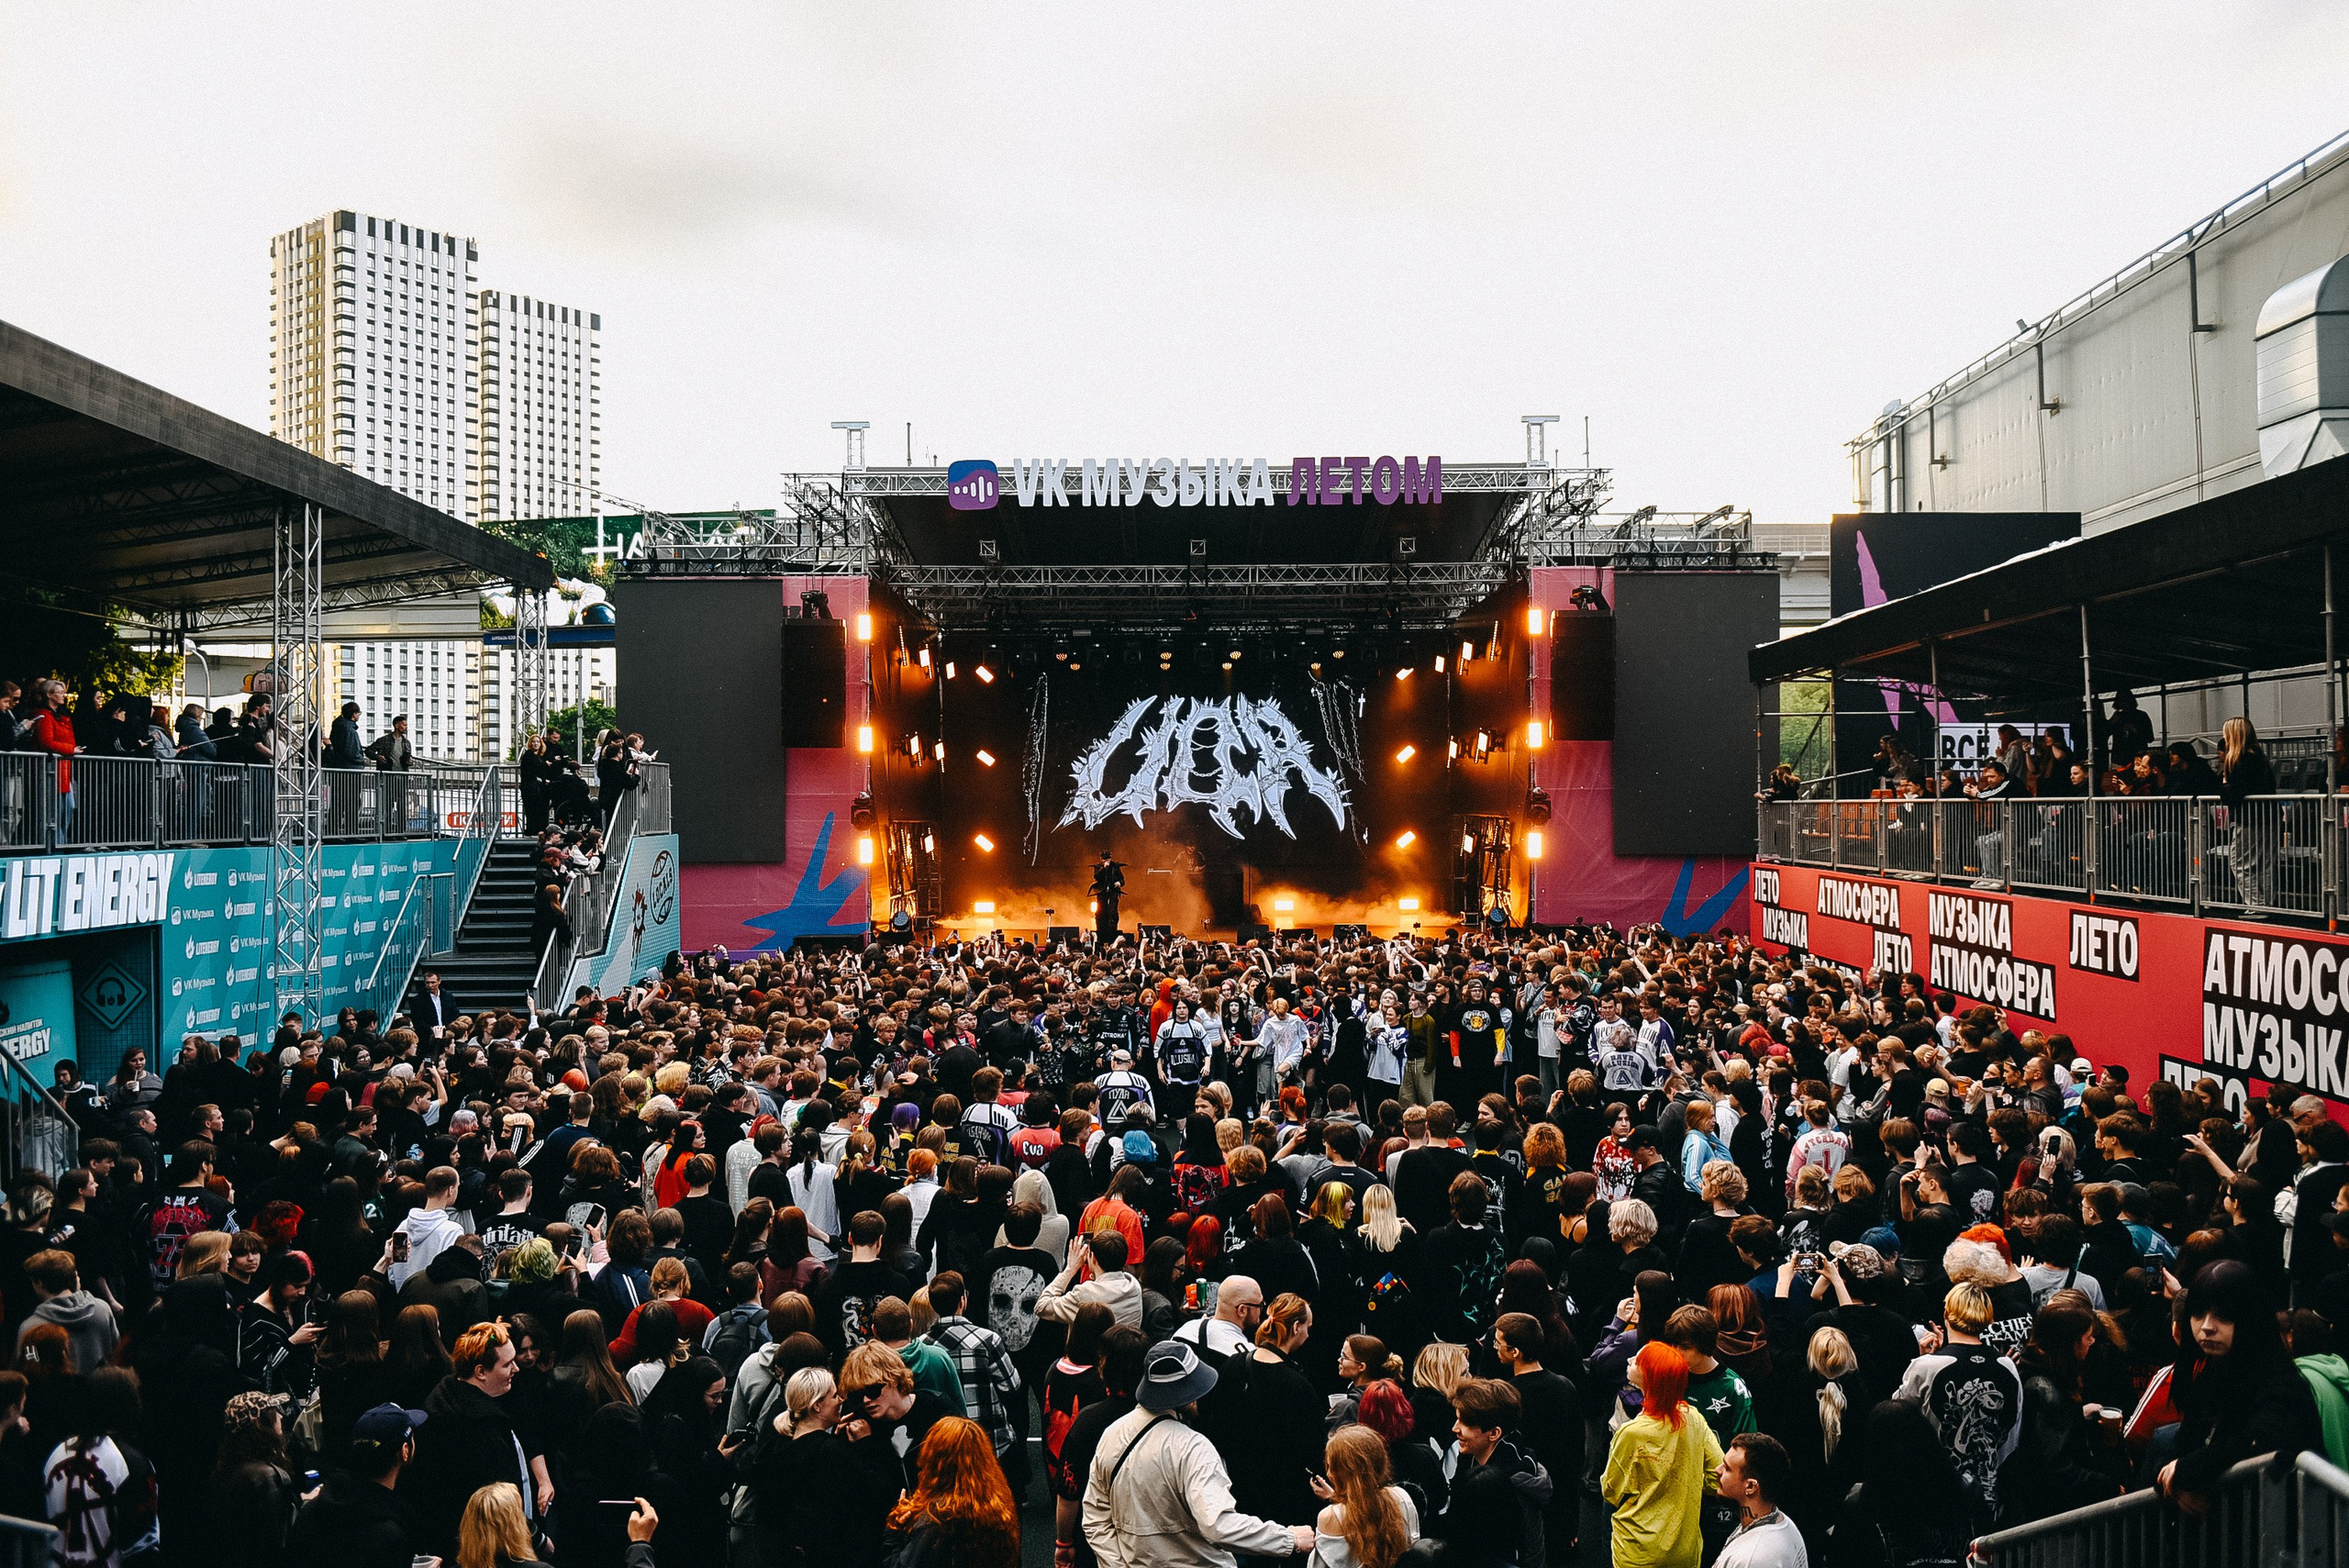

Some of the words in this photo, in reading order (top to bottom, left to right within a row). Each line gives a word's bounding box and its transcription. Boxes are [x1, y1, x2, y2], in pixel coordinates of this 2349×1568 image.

[1013, 458, 1069, 506] VK
[1083, 458, 1275, 507] МУЗЫКА
[1286, 455, 1442, 506] ЛЕТОМ
[1942, 729, 1990, 769] ВСЁ
[59, 853, 174, 931] ENERGY
[652, 867, 673, 908] LOCALS
[1754, 869, 1780, 905] ЛЕТО
[1818, 878, 1900, 929] АТМОСФЕРА
[1763, 906, 1809, 950] МУЗЫКА
[1929, 893, 2011, 951] МУЗЫКА
[2070, 914, 2139, 976] ЛЕТО
[1874, 930, 1912, 974] ЛЕТО
[2204, 934, 2349, 1016] АТМОС
[1931, 943, 2055, 1018] АТМОСФЕРА
[2204, 1002, 2349, 1098] МУЗЫК
[1979, 1329, 2028, 1346] TEAM
[1985, 1312, 2032, 1334] CHIES
[1718, 1510, 1731, 1521] 42
